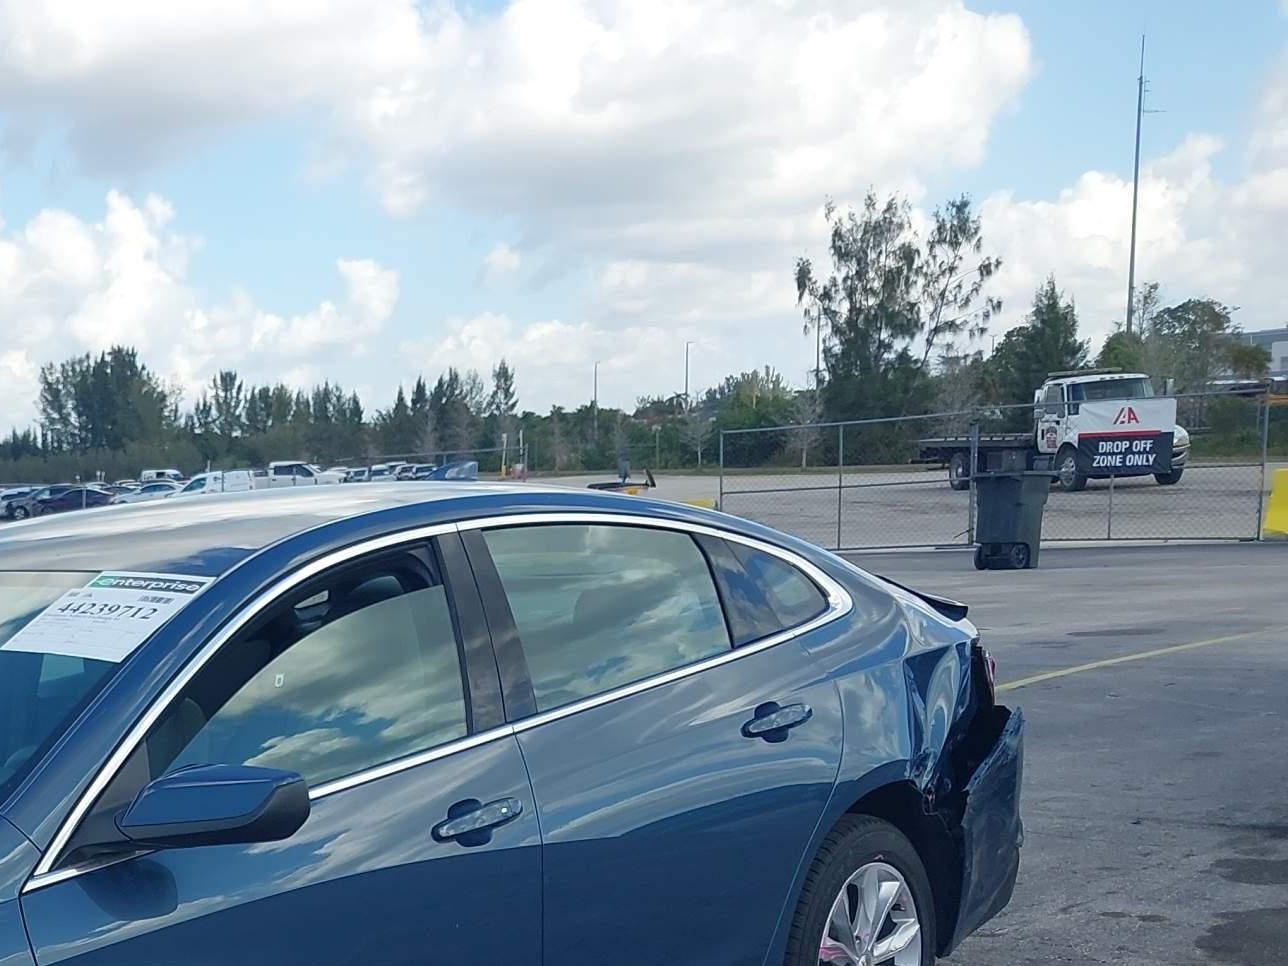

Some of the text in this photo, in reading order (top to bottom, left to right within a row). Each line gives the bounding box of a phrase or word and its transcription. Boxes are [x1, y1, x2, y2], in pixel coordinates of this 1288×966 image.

[1098, 440, 1153, 453] DROP OFF
[1092, 454, 1156, 467] ZONE ONLY
[97, 575, 201, 592] enterprise
[58, 601, 159, 620] 44239712
